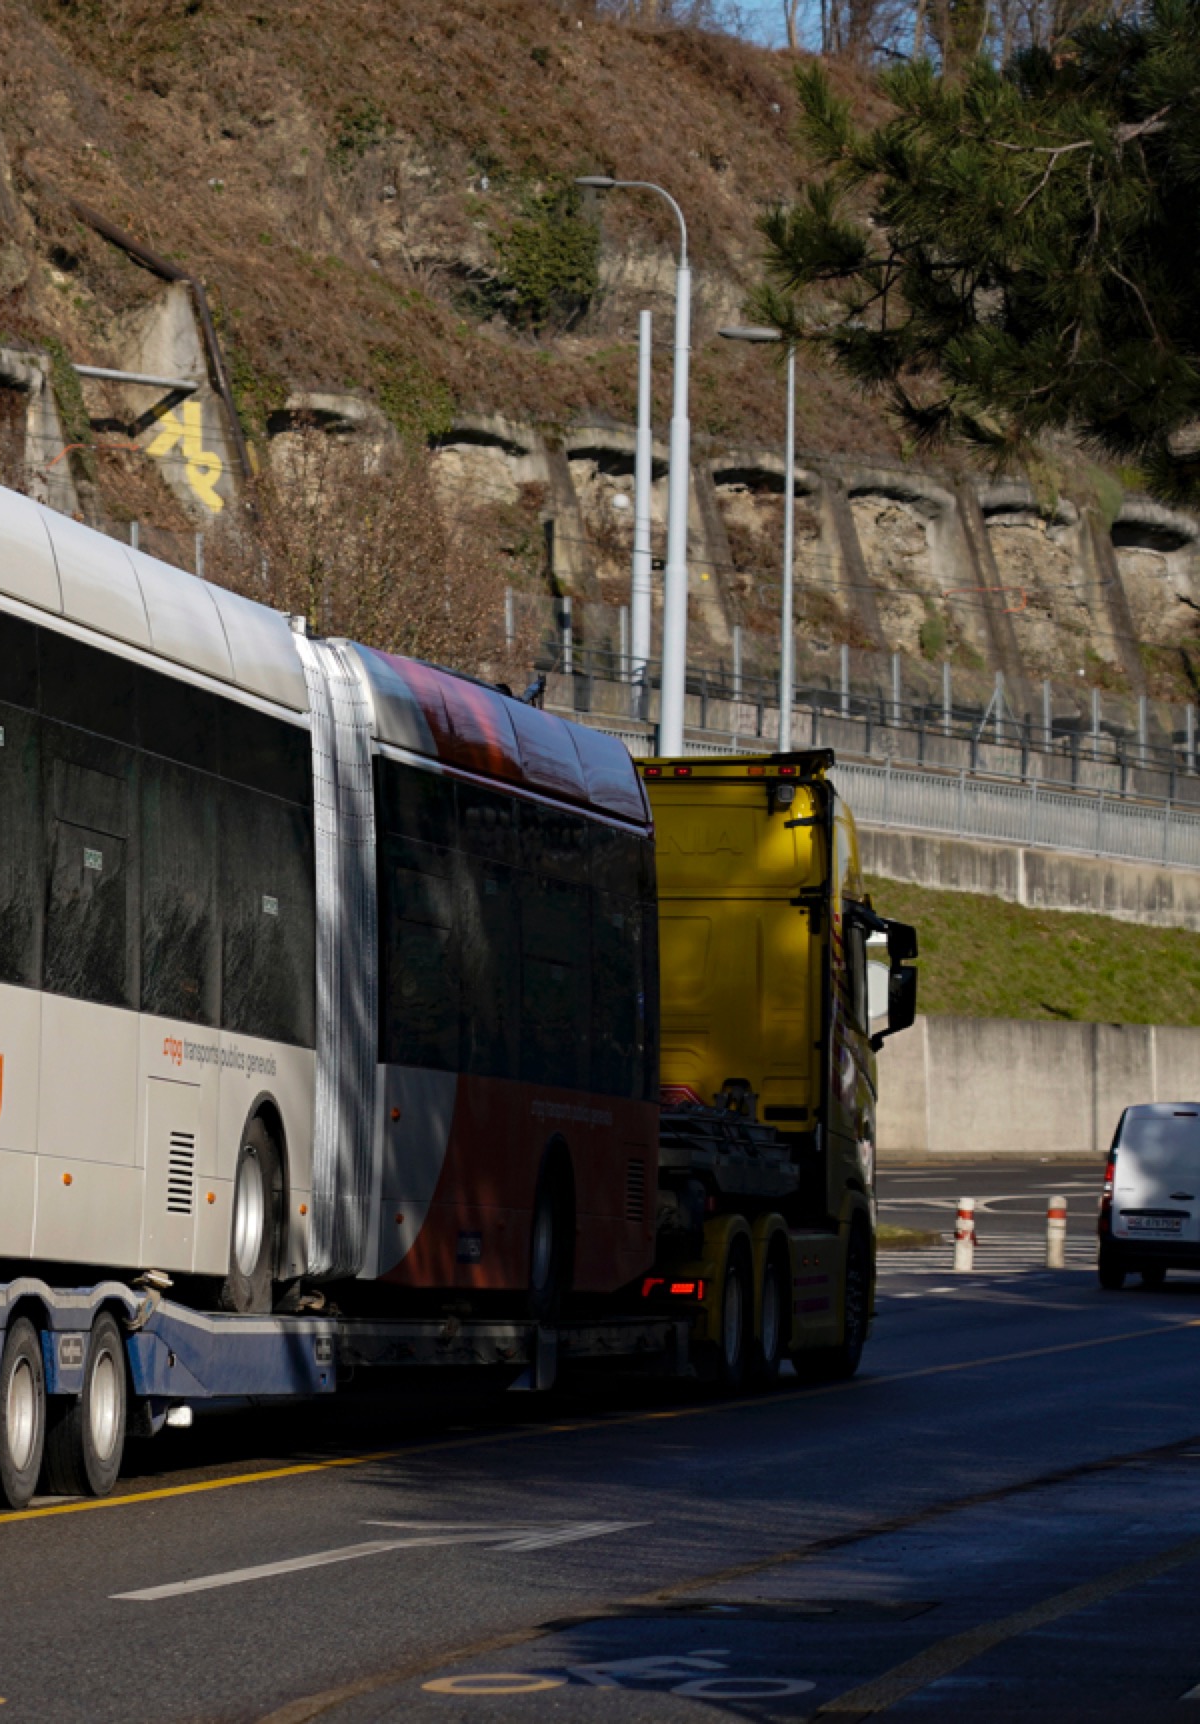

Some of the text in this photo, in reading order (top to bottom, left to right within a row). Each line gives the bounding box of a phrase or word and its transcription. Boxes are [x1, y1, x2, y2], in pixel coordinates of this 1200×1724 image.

[183, 1038, 218, 1069] transports
[220, 1042, 245, 1072] publics
[246, 1053, 276, 1078] genevois
